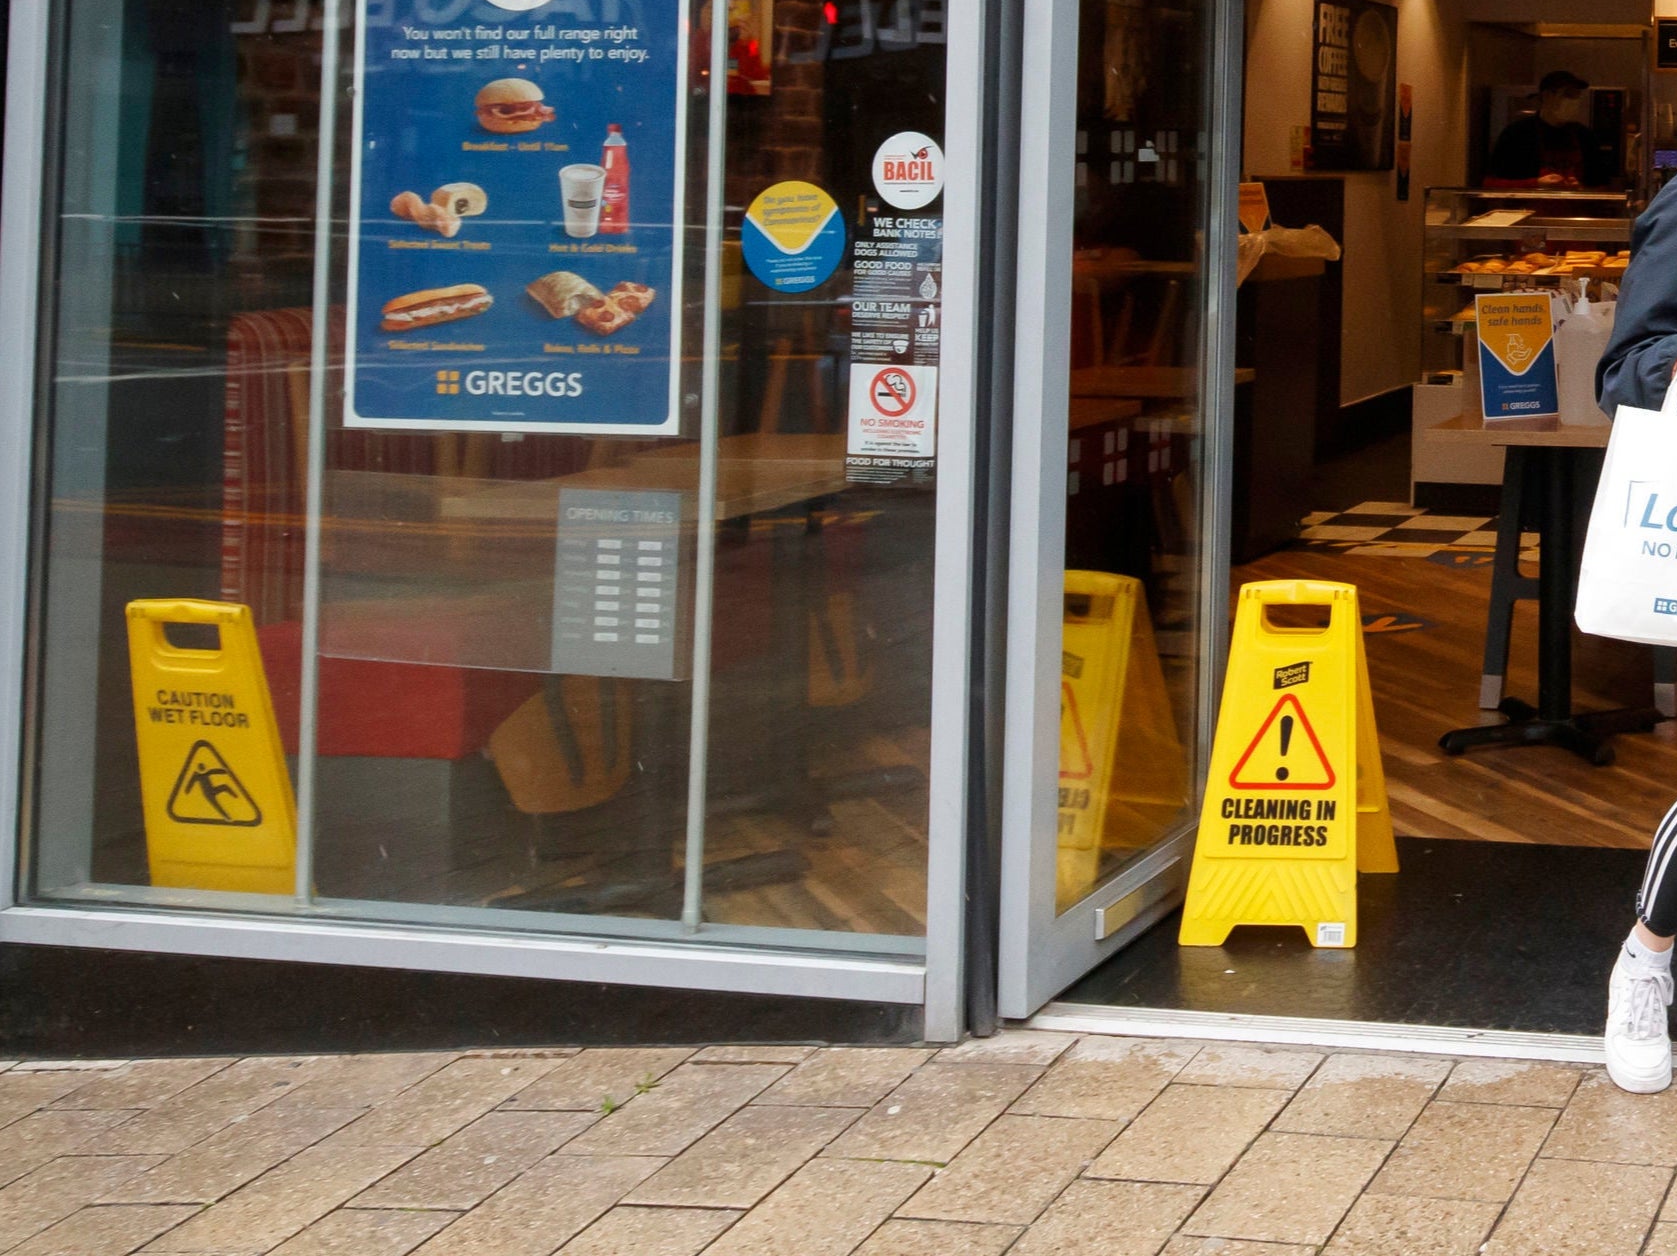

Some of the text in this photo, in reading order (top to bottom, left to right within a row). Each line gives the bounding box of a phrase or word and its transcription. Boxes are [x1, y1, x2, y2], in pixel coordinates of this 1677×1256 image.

[403, 26, 637, 43] You won't find our full range right
[392, 46, 649, 63] now but we still have plenty to enjoy.
[884, 160, 935, 181] BACIL
[873, 218, 936, 229] WE CHECK
[873, 228, 901, 238] BANK
[854, 248, 877, 256] DOGS
[854, 260, 883, 269] GOOD
[885, 261, 912, 270] FOOD
[853, 301, 911, 312] OUR TEAM
[1482, 304, 1509, 314] Clean
[1488, 316, 1542, 326] safe hands
[466, 370, 583, 397] GREGGS
[1510, 401, 1541, 410] GREGGS
[861, 418, 925, 429] NO SMOKING
[846, 457, 935, 468] FOOD FOR THOUGHT
[566, 507, 674, 524] OPENING TIMES
[1642, 540, 1671, 557] NO
[1276, 665, 1307, 679] Robert
[1281, 674, 1306, 686] Scott
[157, 690, 234, 709] CAUTION
[148, 707, 250, 728] WET FLOOR
[1221, 798, 1336, 821] CLEANING IN
[1228, 825, 1327, 846] PROGRESS
